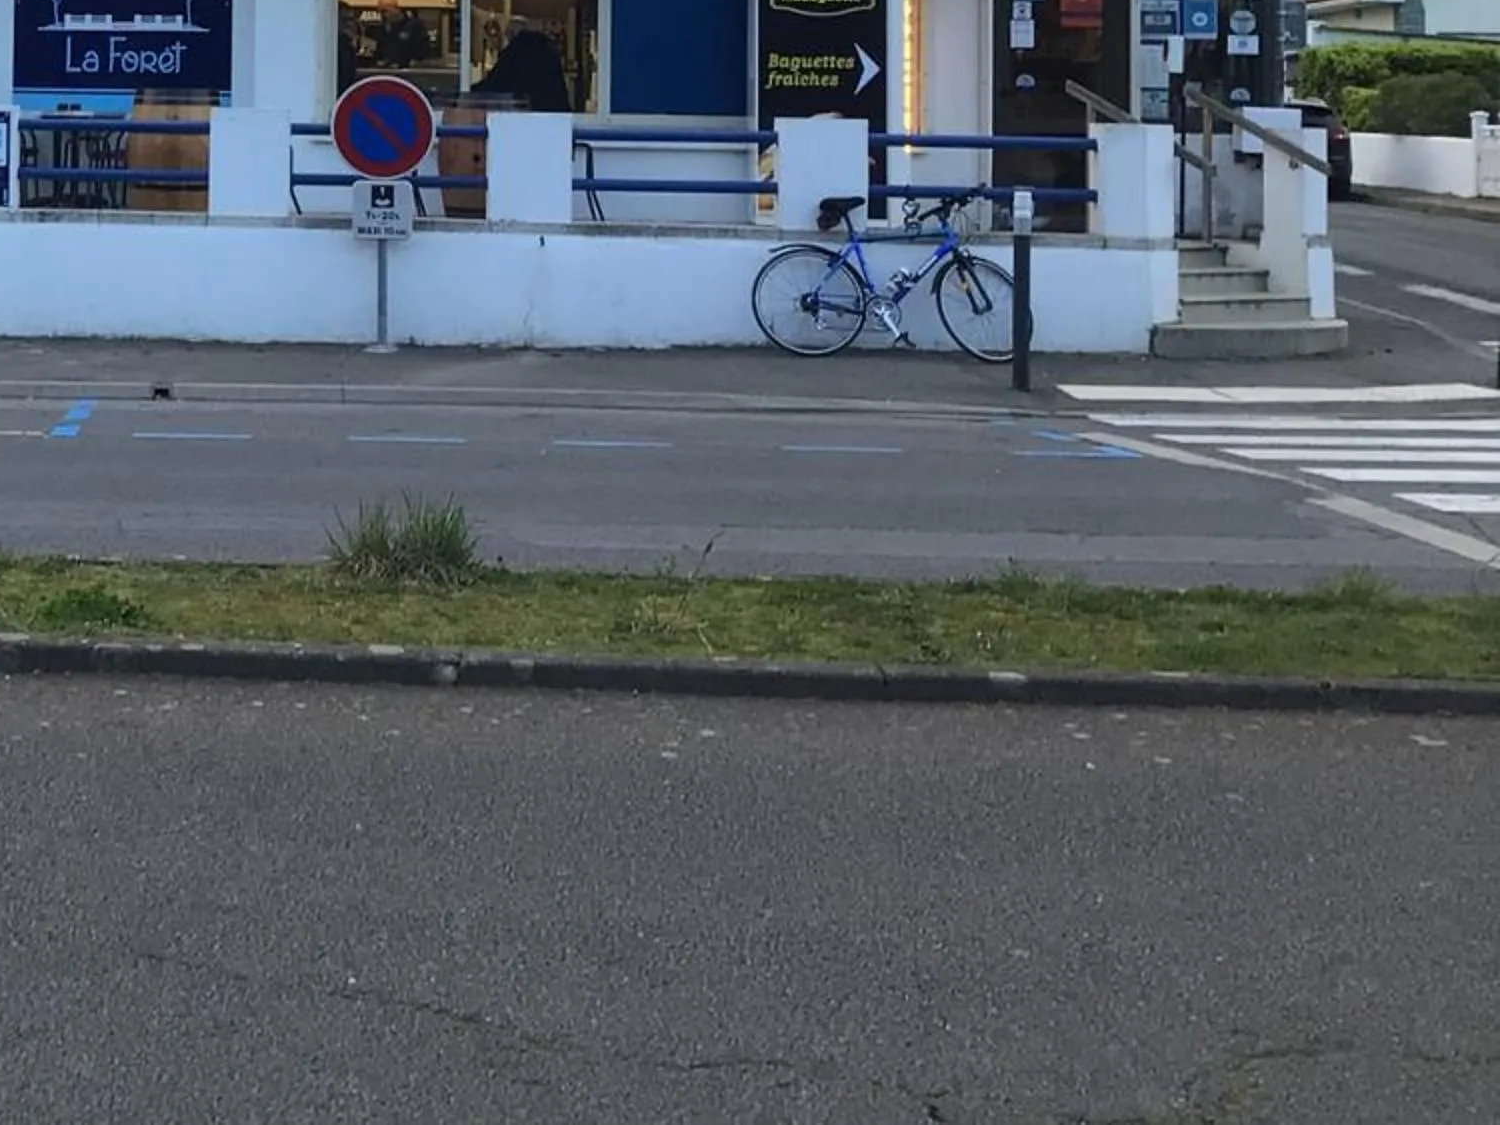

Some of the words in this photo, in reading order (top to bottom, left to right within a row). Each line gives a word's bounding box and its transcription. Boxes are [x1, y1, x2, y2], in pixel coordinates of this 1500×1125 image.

[65, 35, 100, 73] La
[108, 35, 188, 74] Forêt
[768, 53, 855, 71] Baguettes
